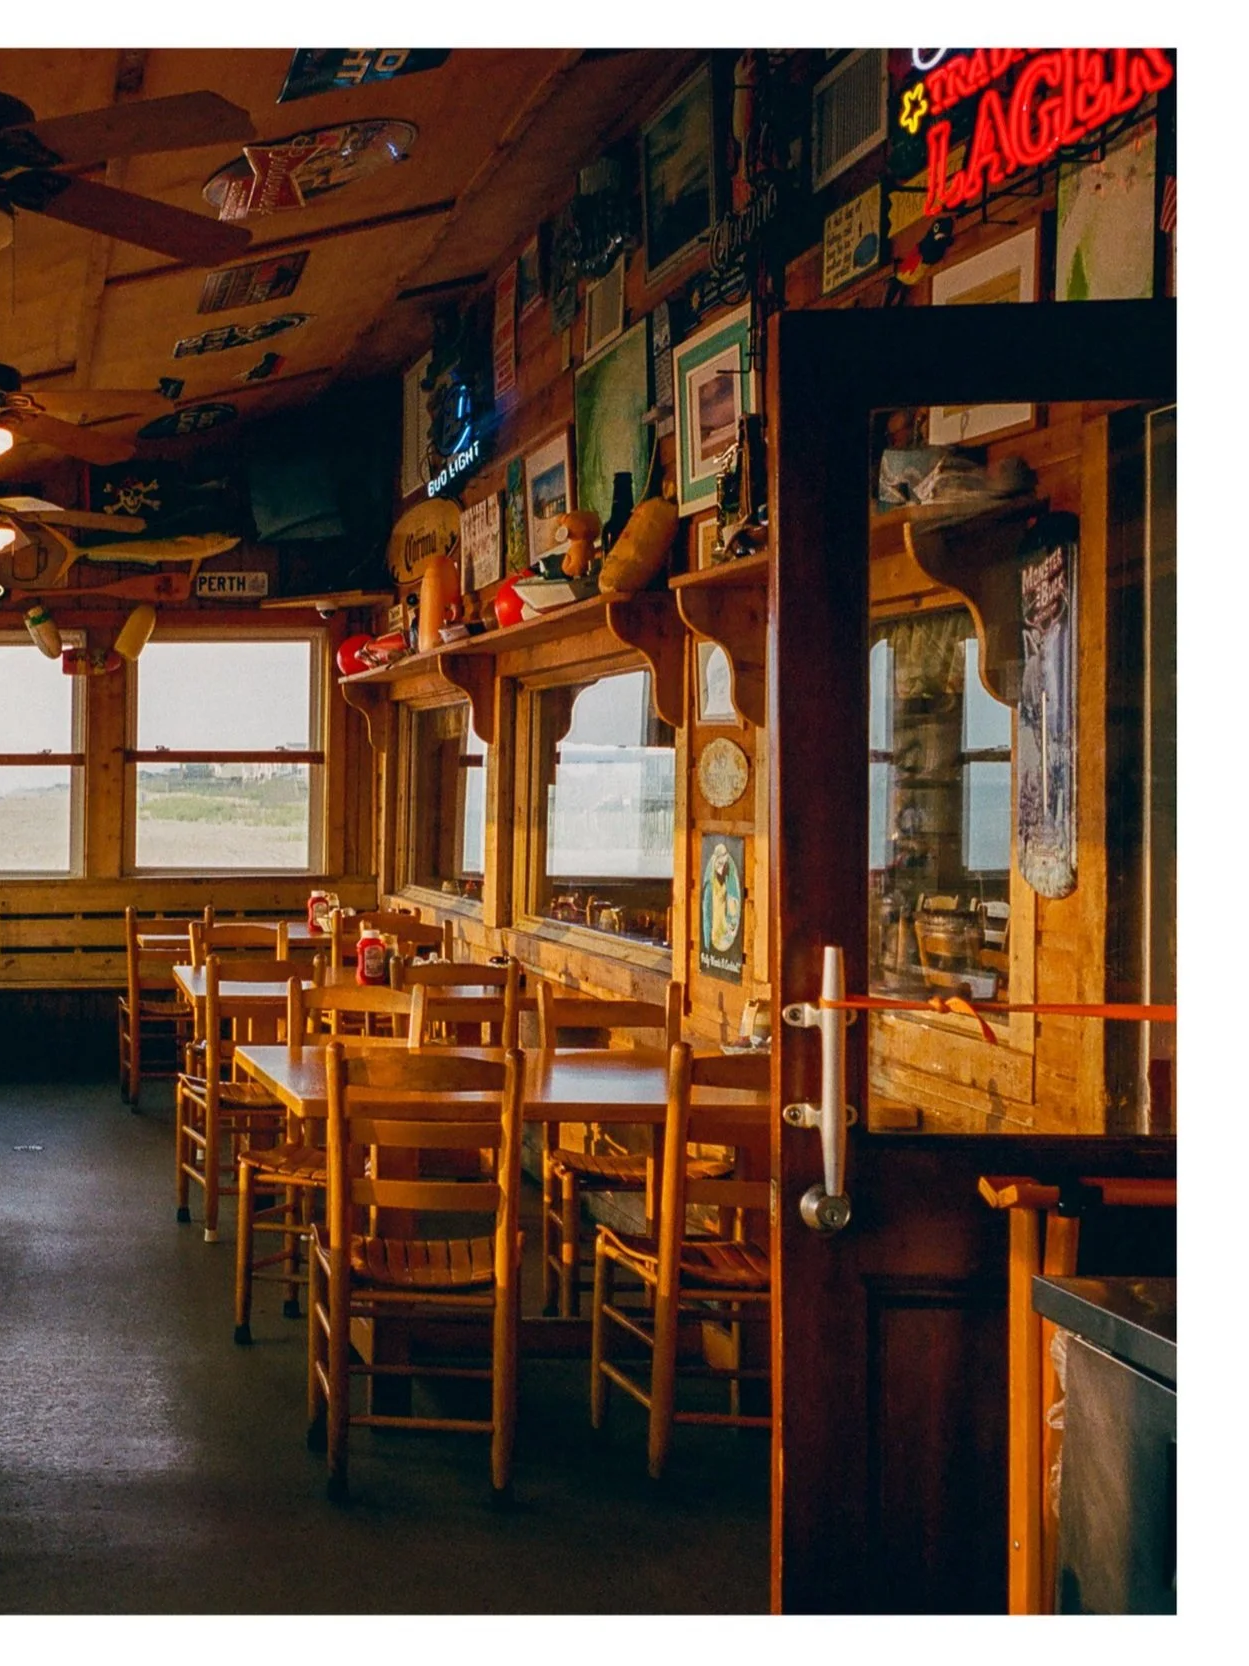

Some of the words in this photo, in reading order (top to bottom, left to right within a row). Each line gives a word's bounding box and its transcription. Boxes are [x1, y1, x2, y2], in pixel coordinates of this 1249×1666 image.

[924, 48, 1173, 216] LAGER
[427, 469, 448, 498] BUD
[449, 440, 480, 482] LIGHT
[406, 531, 437, 573] Corona
[198, 576, 246, 593] PERTH
